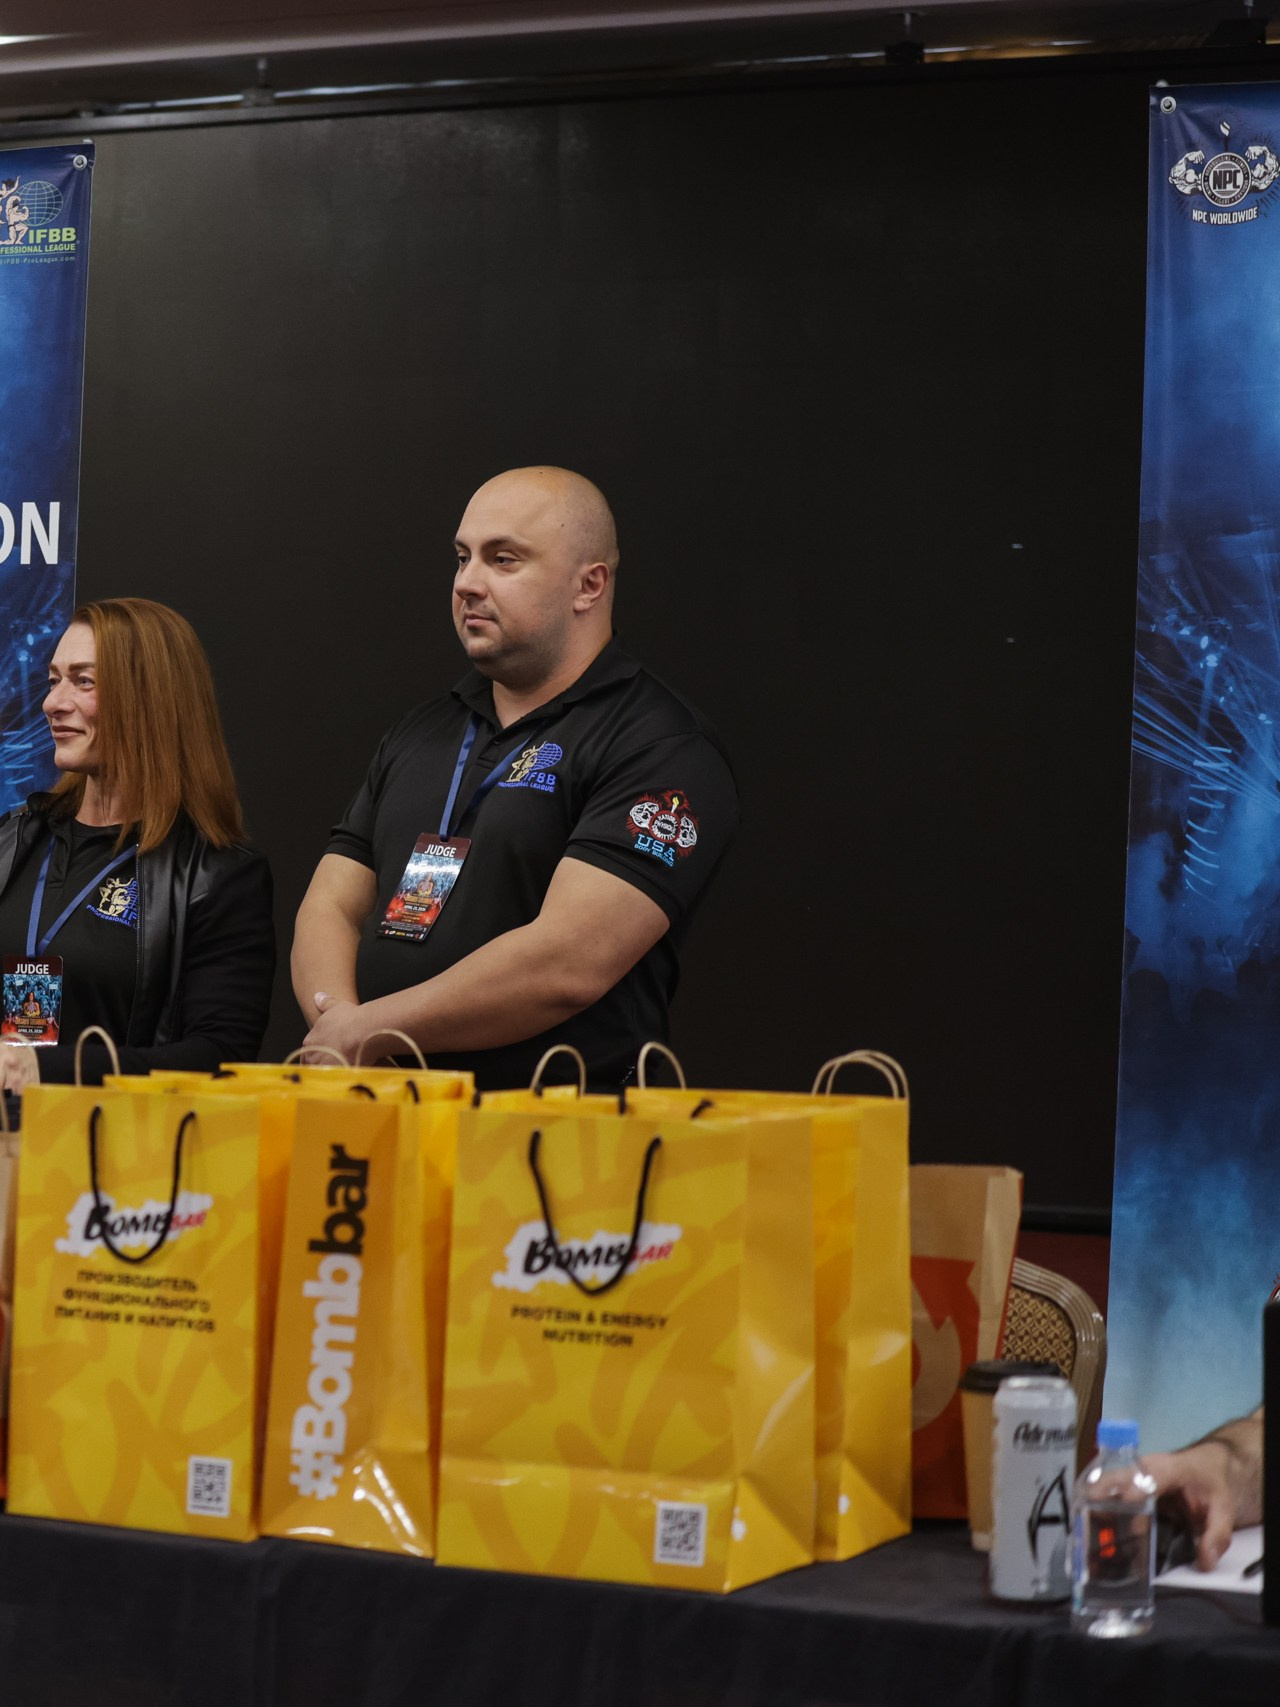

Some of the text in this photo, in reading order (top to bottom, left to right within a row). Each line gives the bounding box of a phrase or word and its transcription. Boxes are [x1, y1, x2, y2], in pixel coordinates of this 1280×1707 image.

[1212, 169, 1241, 190] NPC
[1192, 206, 1258, 225] NPC WORLDWIDE
[28, 227, 76, 244] IFBB
[45, 243, 76, 252] LEAGUE
[530, 782, 555, 793] LEAGUE
[424, 843, 457, 858] JUDGE
[637, 833, 676, 862] USA
[86, 903, 132, 927] PROFESSIONAL
[15, 963, 50, 975] JUDGE
[76, 1269, 199, 1293] ПРОИЗВОДИТЕЛЬ
[63, 1287, 212, 1314] ФУНКЦИОНАЛЬНОГО
[54, 1305, 217, 1335] ПИТАНИЯ И НАПИТКОВ
[288, 1142, 371, 1502] #Bombbar
[511, 1304, 669, 1330] PROTEIN & ENERGY
[541, 1328, 634, 1349] NUTRITION
